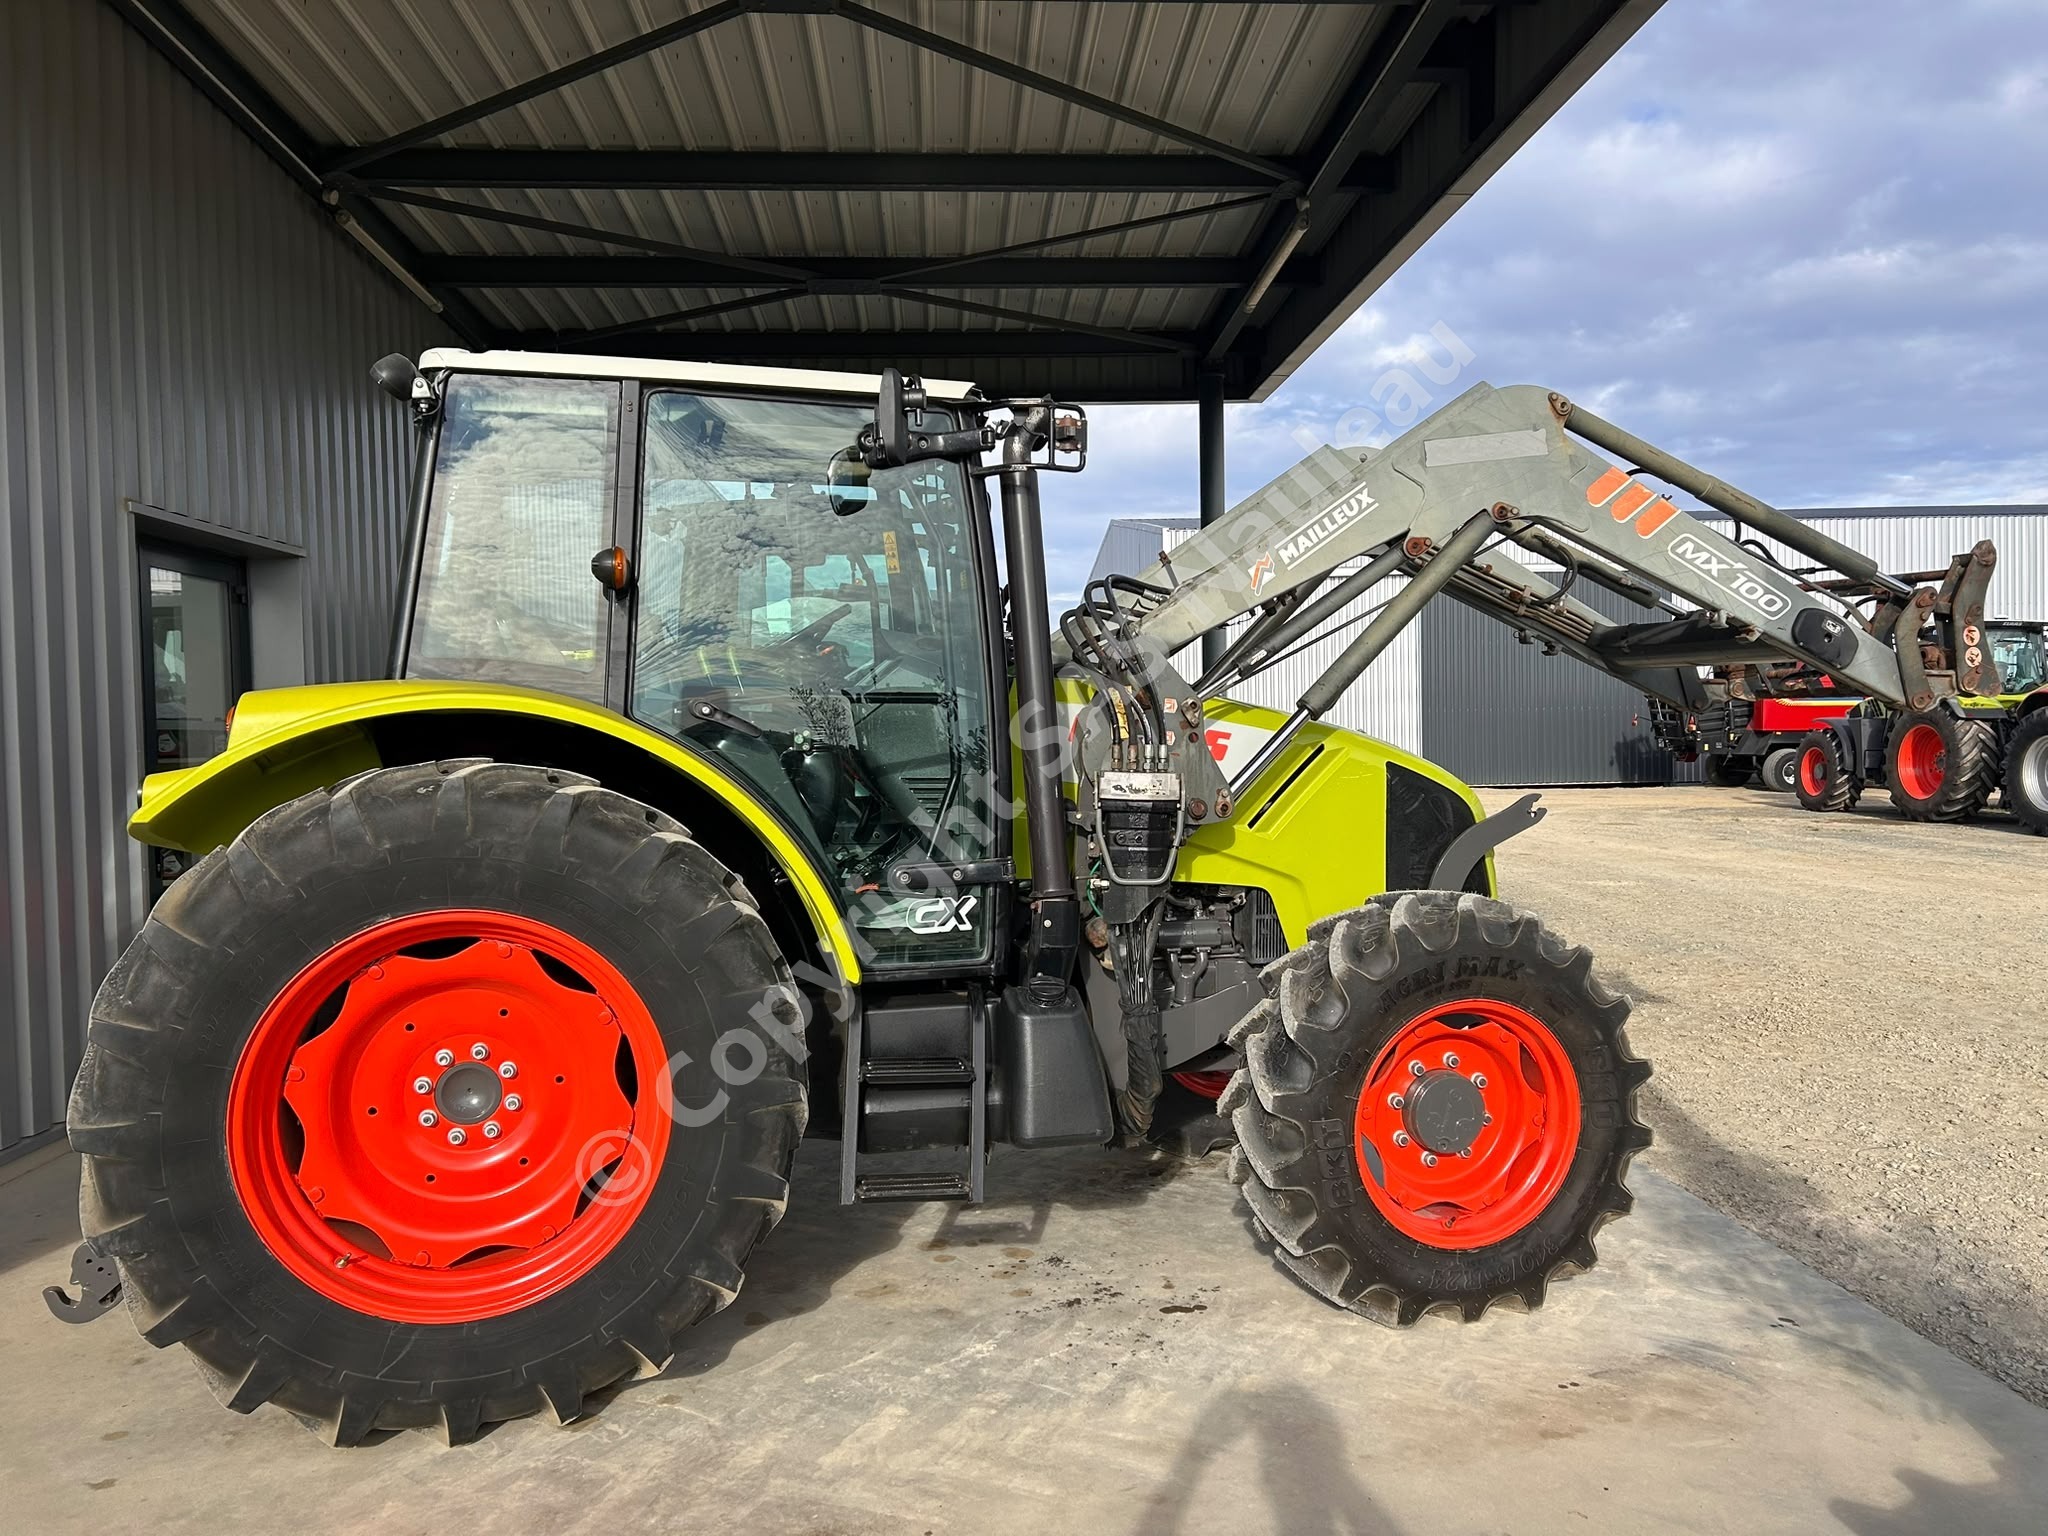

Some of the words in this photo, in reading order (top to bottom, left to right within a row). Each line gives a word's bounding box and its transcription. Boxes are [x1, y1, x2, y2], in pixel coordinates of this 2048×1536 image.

[1278, 487, 1376, 565] MAILLEUX
[1675, 540, 1732, 578] MX
[1729, 572, 1784, 612] 100
[906, 895, 978, 934] CX
